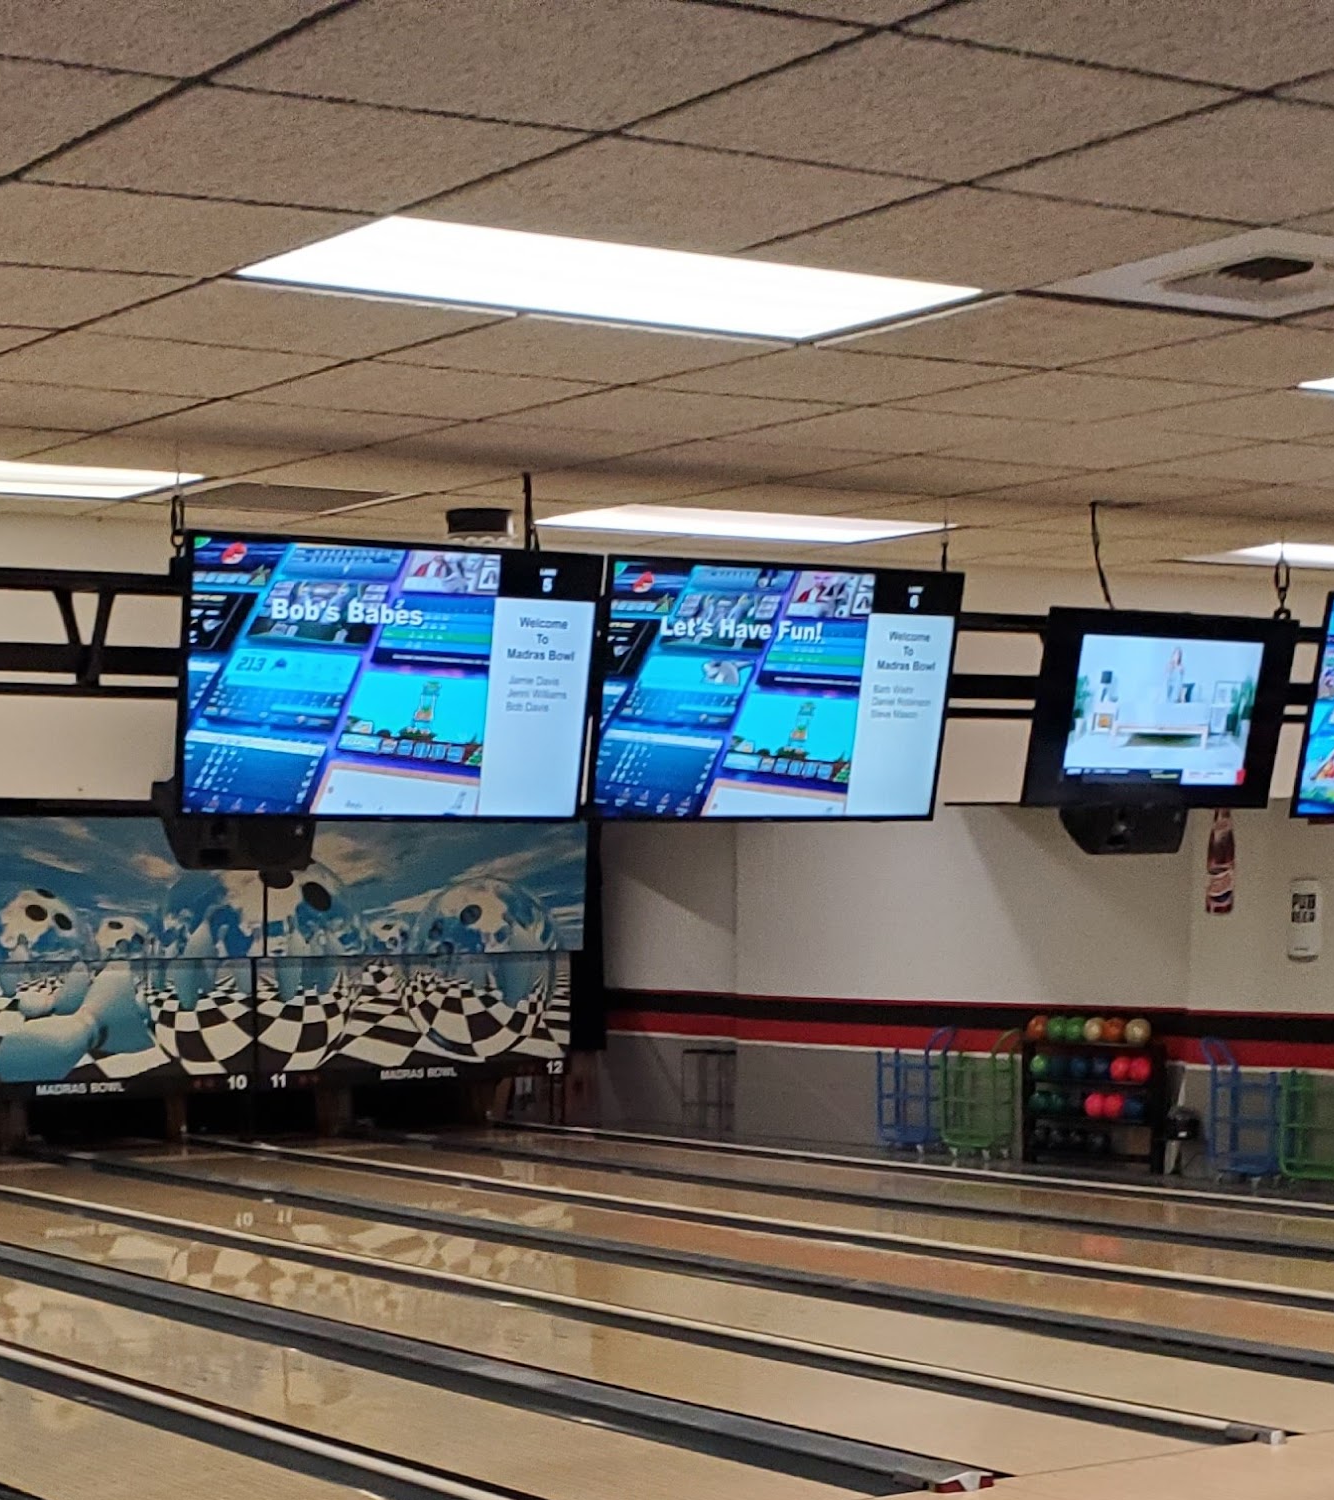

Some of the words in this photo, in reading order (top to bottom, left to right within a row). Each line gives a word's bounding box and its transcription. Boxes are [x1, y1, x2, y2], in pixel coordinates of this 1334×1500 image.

[542, 577, 553, 592] 5
[271, 600, 341, 622] Bob's
[347, 601, 424, 626] Babes
[519, 617, 569, 630] Welcome
[661, 616, 714, 638] Let's
[719, 618, 772, 639] Have
[777, 620, 823, 643] Fun!
[537, 634, 549, 645] To
[507, 648, 545, 660] Madras
[548, 650, 575, 662] Bowl
[381, 1068, 425, 1080] MADRAS
[427, 1067, 457, 1078] BOWL
[546, 1061, 563, 1074] 12
[228, 1074, 247, 1090] 10
[271, 1074, 286, 1089] 11
[36, 1083, 87, 1096] MADRAS
[90, 1082, 125, 1094] BOWL
